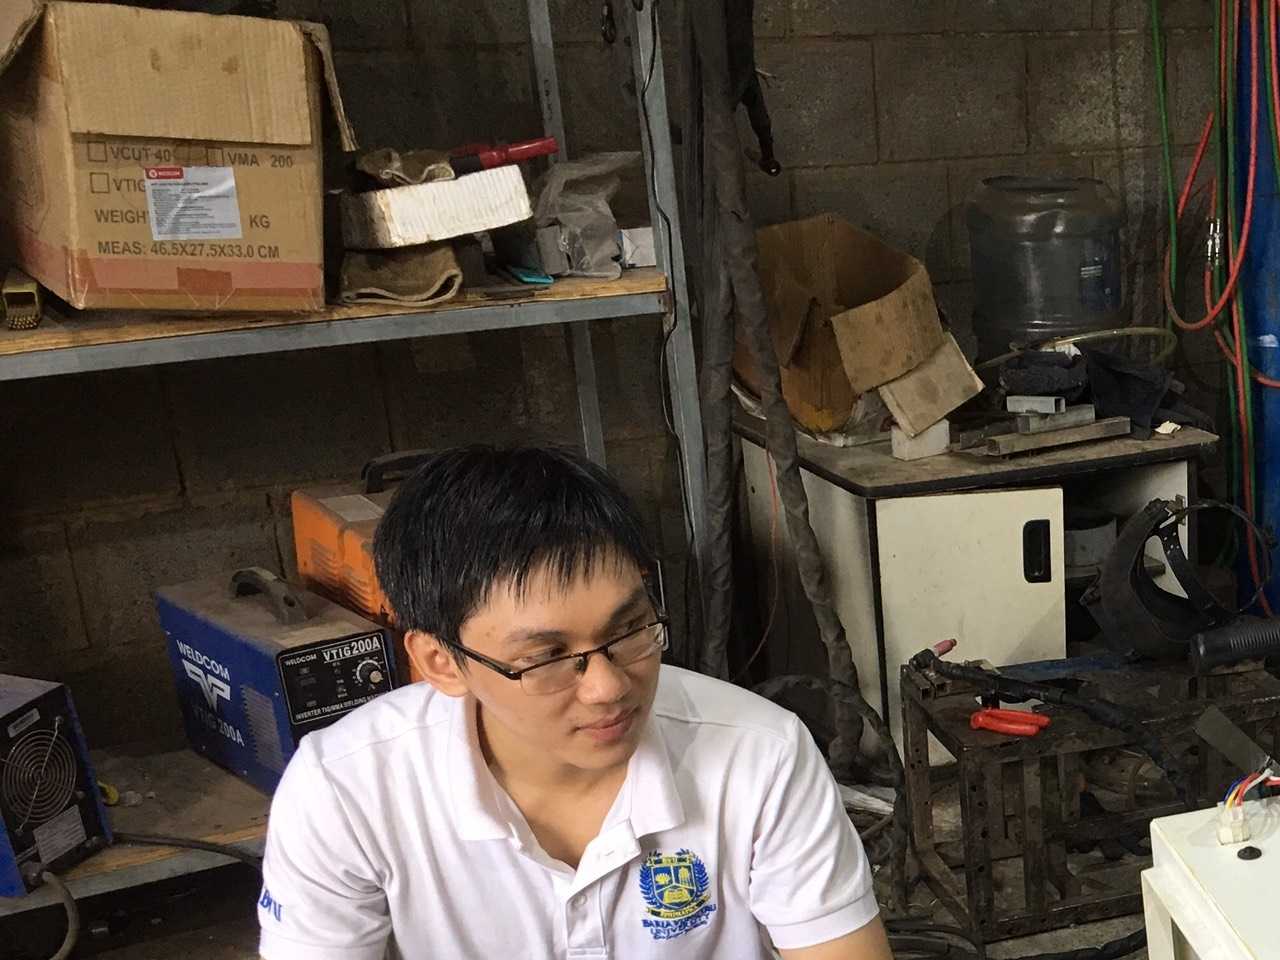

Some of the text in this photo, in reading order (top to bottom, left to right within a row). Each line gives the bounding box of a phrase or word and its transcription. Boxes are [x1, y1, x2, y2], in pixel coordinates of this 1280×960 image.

[227, 151, 294, 169] VMA 200
[94, 209, 271, 229] WEIGH KG
[98, 241, 146, 255] MEAS:
[257, 245, 280, 259] CM
[176, 639, 231, 681] WELDCOM
